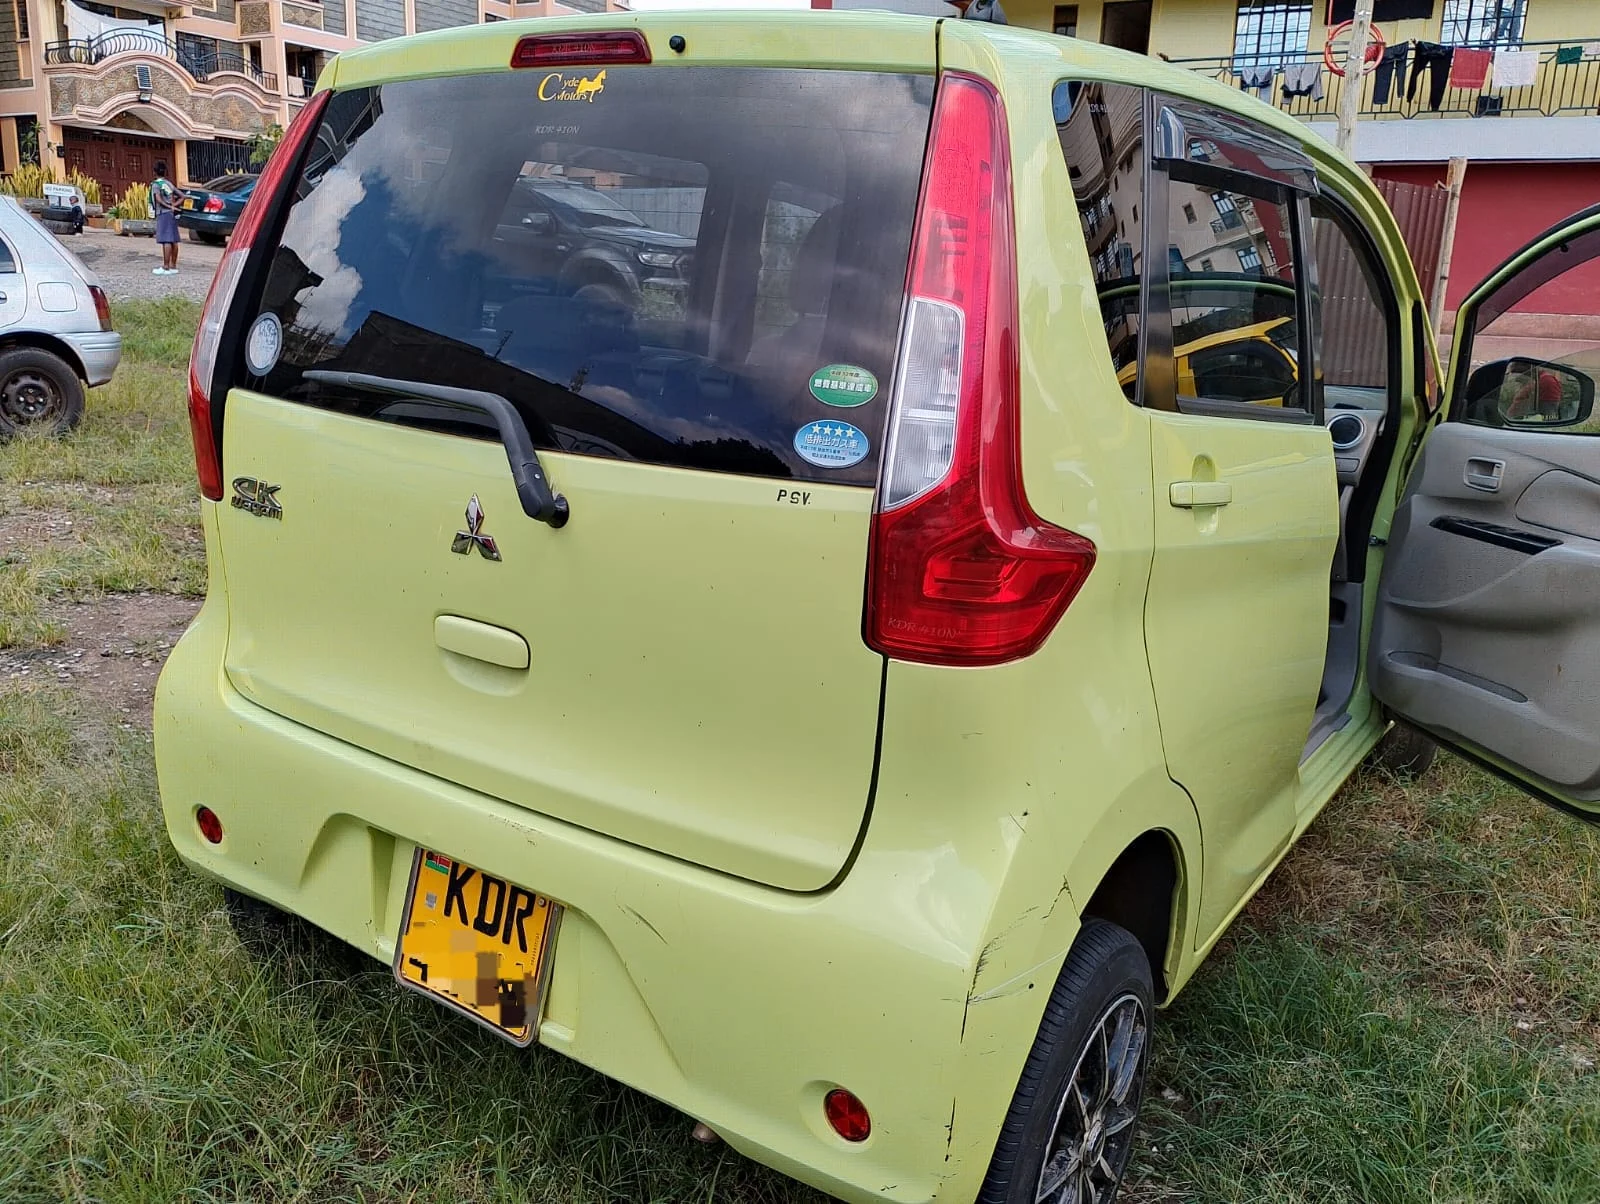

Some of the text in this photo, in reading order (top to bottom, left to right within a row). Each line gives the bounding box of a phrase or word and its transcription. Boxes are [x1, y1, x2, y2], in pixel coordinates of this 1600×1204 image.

[554, 89, 590, 102] Motors
[535, 124, 555, 135] KDR
[887, 617, 917, 633] KDR
[443, 861, 537, 953] KDR
